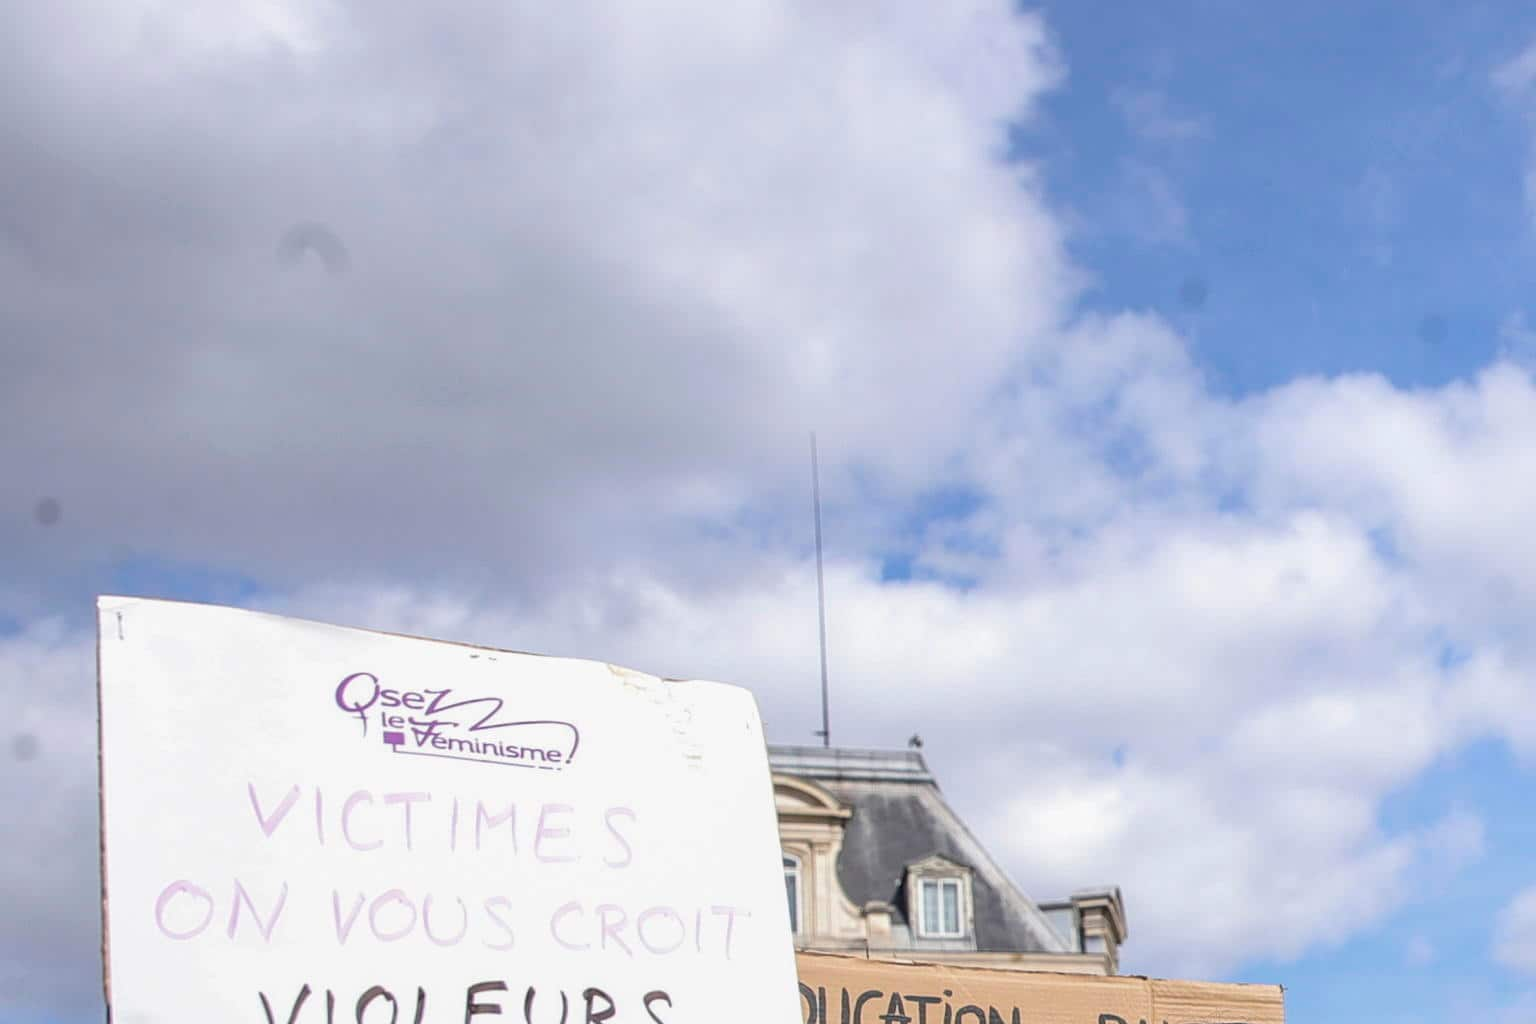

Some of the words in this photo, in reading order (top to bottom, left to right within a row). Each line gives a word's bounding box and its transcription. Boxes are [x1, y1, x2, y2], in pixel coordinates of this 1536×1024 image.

[381, 711, 405, 729] le
[247, 782, 639, 869] VICTIMES
[155, 879, 289, 943] ON
[332, 887, 516, 953] VOUS
[549, 900, 752, 961] CROIT
